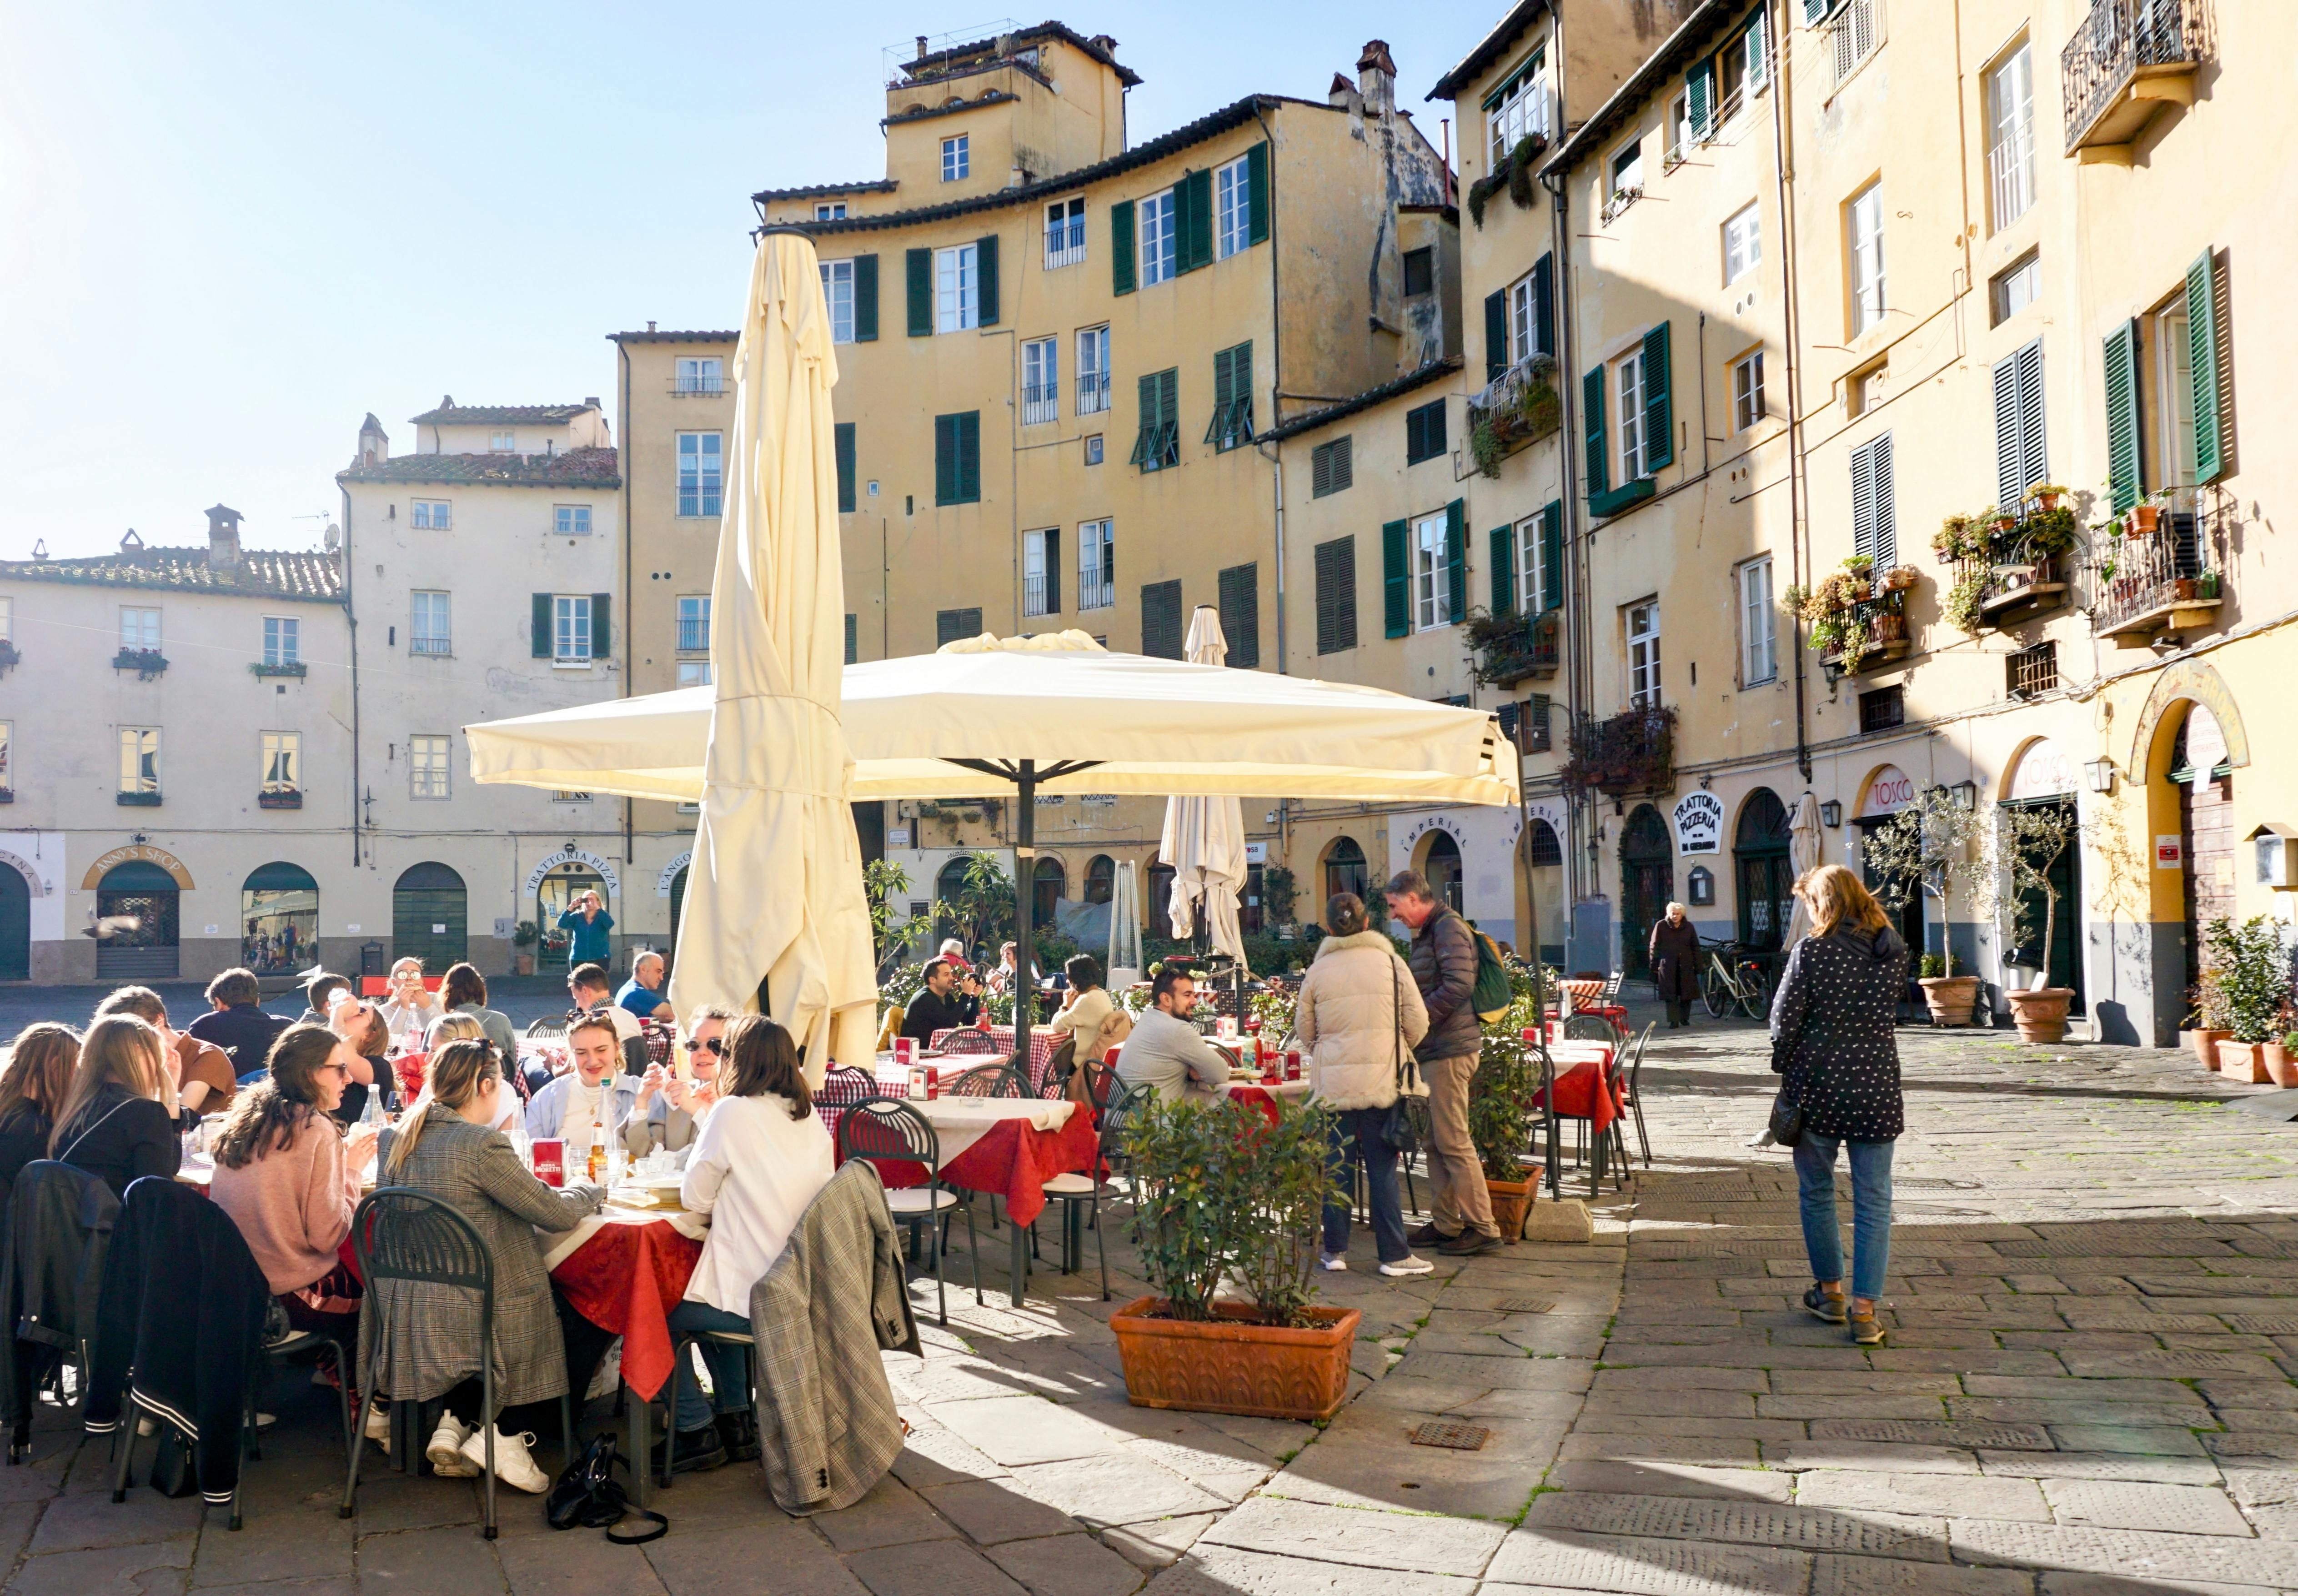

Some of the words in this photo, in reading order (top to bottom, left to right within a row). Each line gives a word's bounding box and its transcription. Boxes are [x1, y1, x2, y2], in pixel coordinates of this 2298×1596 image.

[1874, 779, 1913, 805] TOSCO
[1674, 795, 1721, 821] TRATTORIA
[1404, 818, 1466, 851] IMPERIAL
[1510, 806, 1564, 844] IMERIAL
[1680, 811, 1715, 835] PIZZERIA
[96, 847, 139, 873] ANNY'S
[146, 848, 181, 870] SHOP
[527, 851, 587, 891] TRATTORIA
[592, 858, 618, 889] PIZZA
